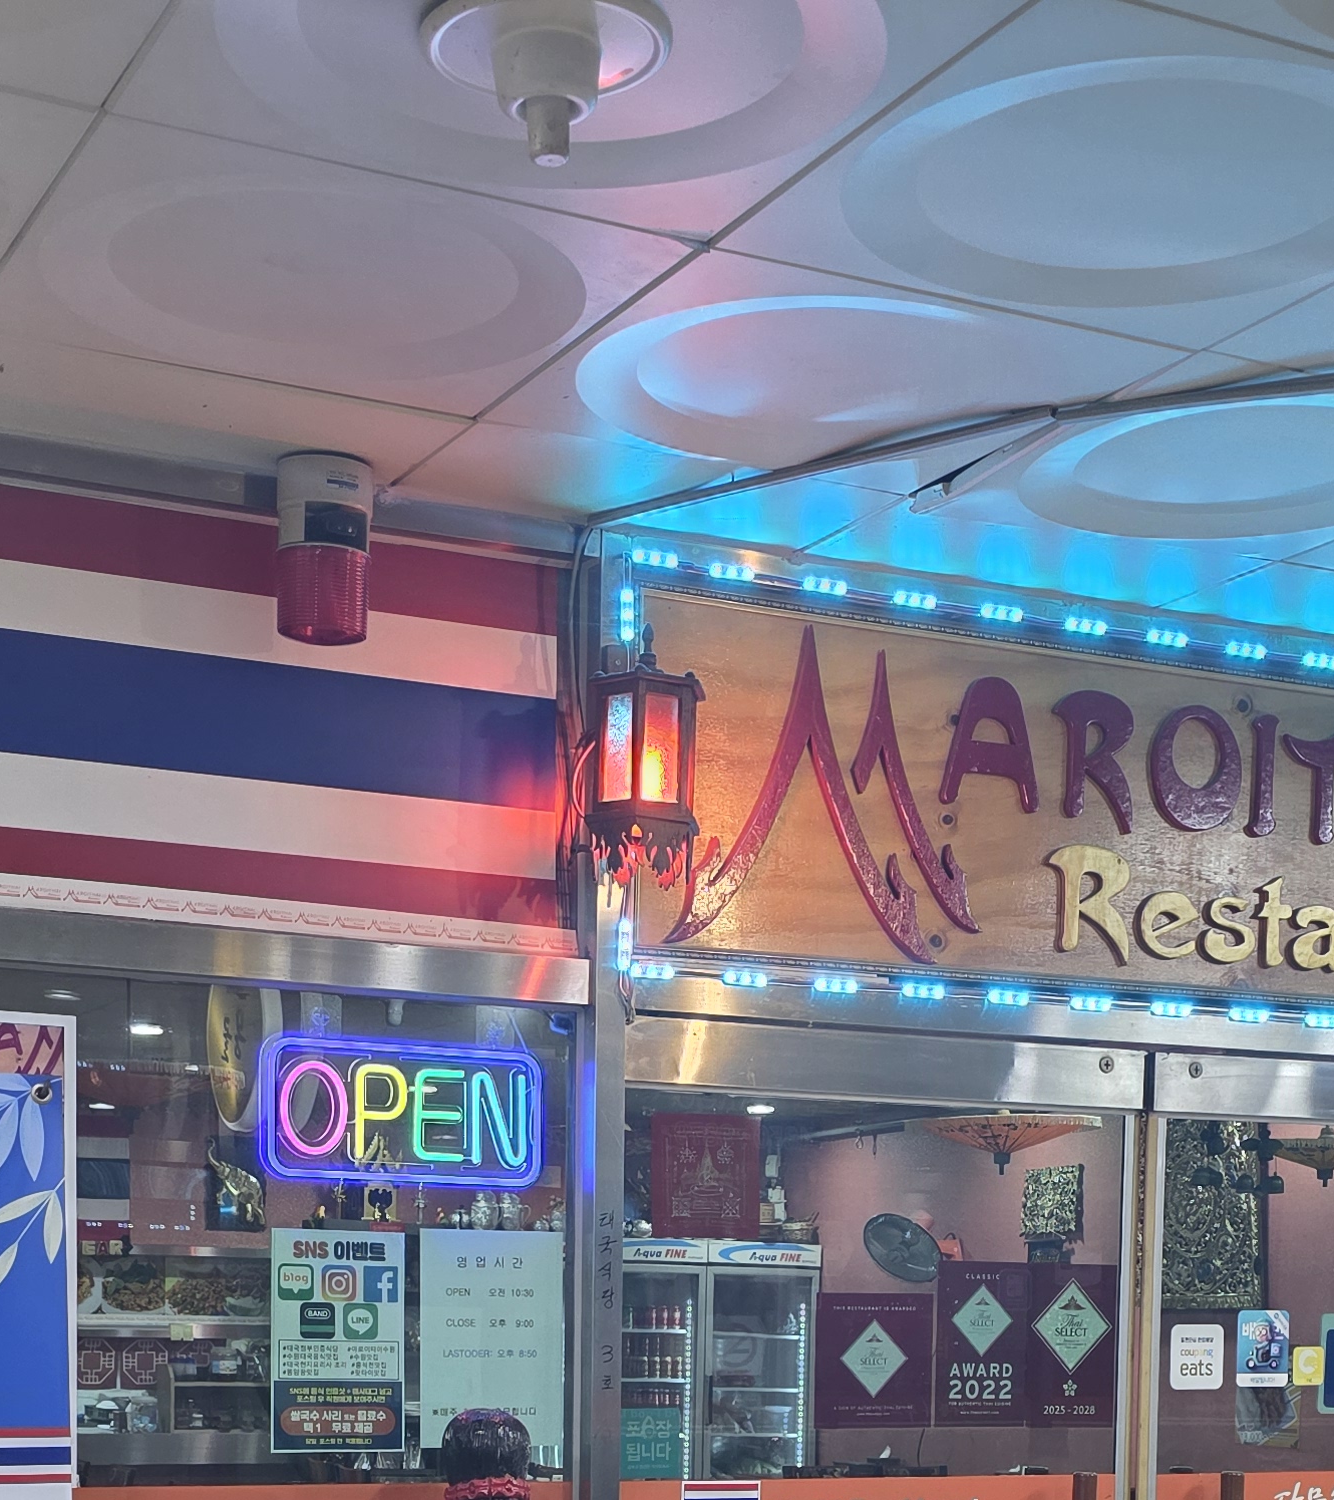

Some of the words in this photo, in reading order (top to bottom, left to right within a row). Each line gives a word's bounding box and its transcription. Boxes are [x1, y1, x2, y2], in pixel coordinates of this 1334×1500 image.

[279, 1059, 529, 1170] OPEN
[293, 1240, 329, 1259] SNS
[334, 1241, 386, 1261] 이벤트
[633, 1248, 662, 1258] Aqua
[665, 1249, 687, 1259] FINE
[749, 1252, 777, 1262] Aqua
[779, 1253, 802, 1262] FINE
[284, 1272, 308, 1284] blog
[446, 1288, 471, 1296] OPEN
[489, 1289, 505, 1297] 오전
[511, 1289, 534, 1297] 10:30
[351, 1316, 369, 1324] LINE
[446, 1319, 476, 1328] CLOSE
[489, 1319, 506, 1328] 오후
[515, 1320, 534, 1328] 9:00
[970, 1319, 994, 1327] SELECT
[1055, 1328, 1088, 1337] SELECT
[497, 1350, 514, 1358] 오후
[519, 1350, 537, 1358] 8:50
[1180, 1348, 1214, 1358] coupang
[860, 1358, 888, 1366] SELECT
[950, 1363, 1013, 1377] AWARD
[1180, 1359, 1213, 1377] eats
[949, 1380, 1012, 1399] 2022
[1043, 1406, 1065, 1414] 2025
[1073, 1406, 1095, 1414] 2028
[290, 1410, 319, 1421] 쌀국수
[322, 1411, 341, 1421] 사리
